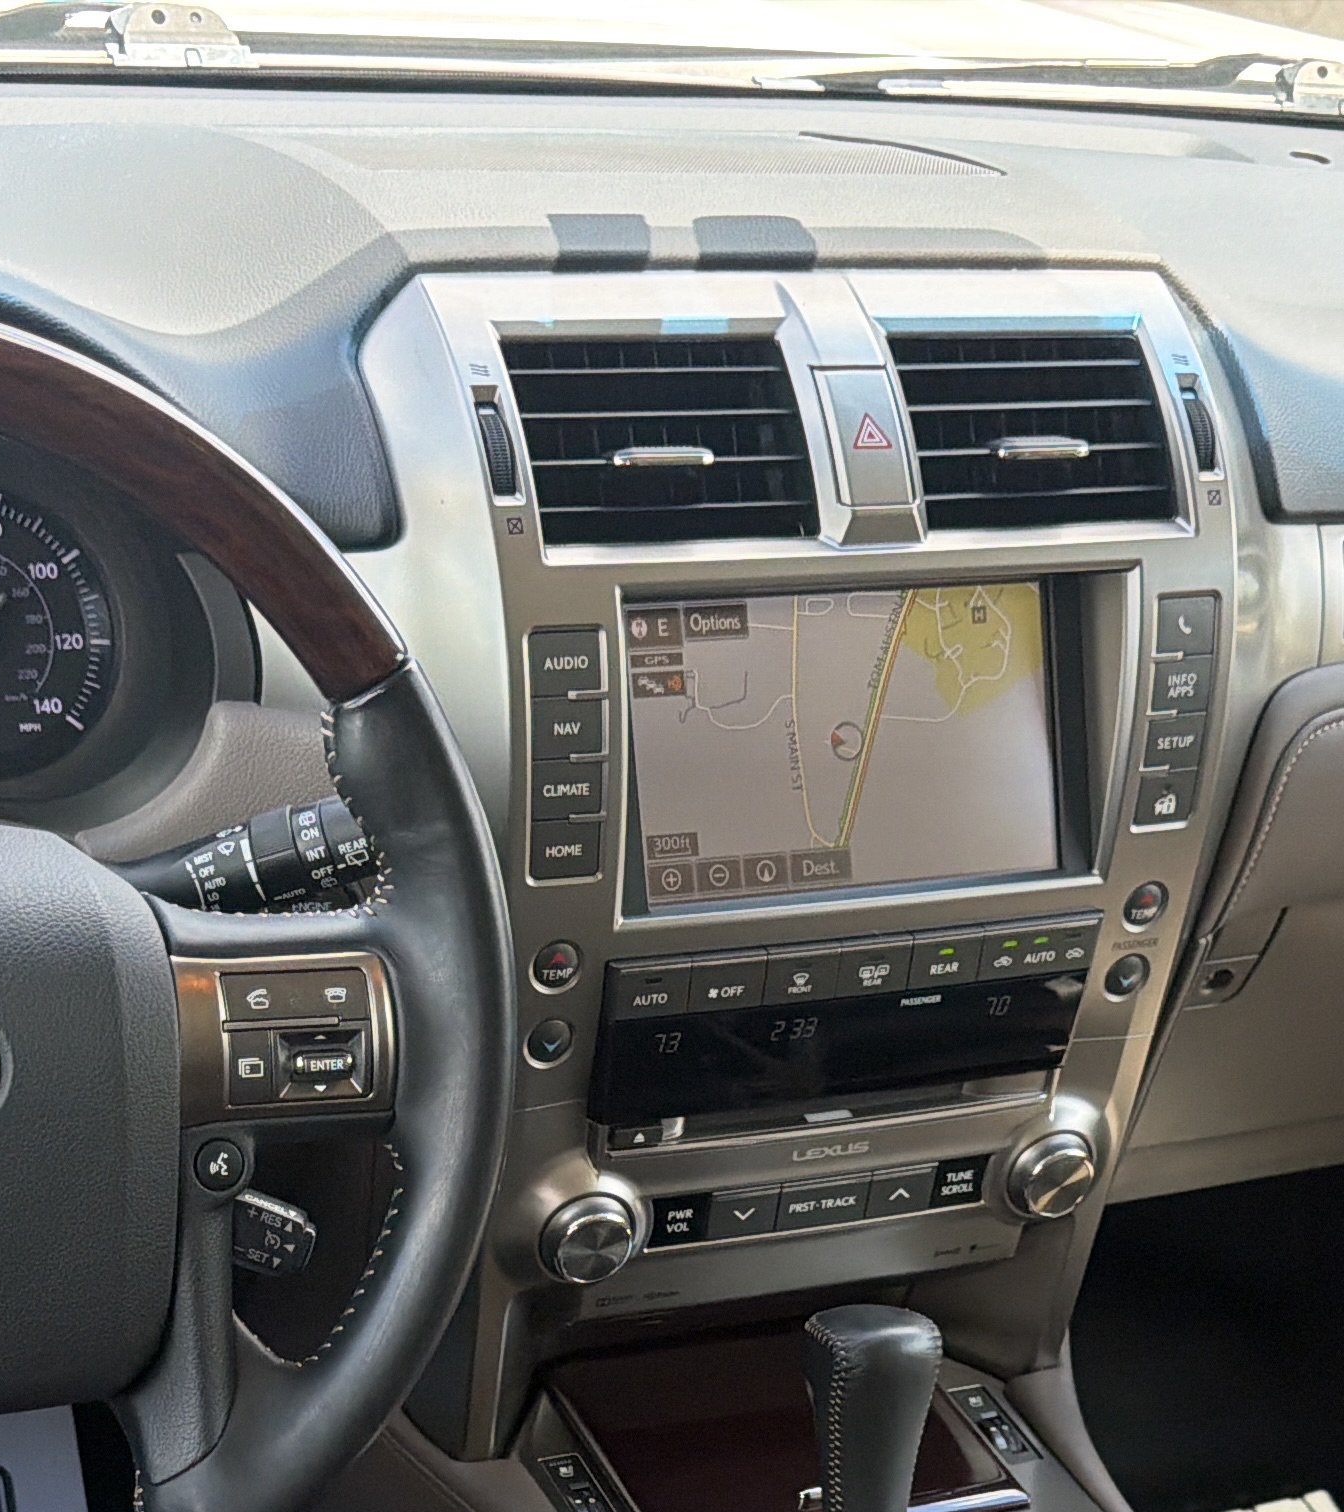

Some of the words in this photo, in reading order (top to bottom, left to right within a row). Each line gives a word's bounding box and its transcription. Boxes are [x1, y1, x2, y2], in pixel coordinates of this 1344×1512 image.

[28, 562, 58, 580] 100
[657, 618, 670, 637] E
[689, 612, 742, 636] Options
[54, 633, 84, 652] 120
[544, 655, 589, 671] AUDIO
[644, 655, 670, 665] GPS
[1168, 672, 1198, 687] INFO
[1167, 686, 1195, 700] APPS
[33, 697, 63, 715] 140
[19, 723, 42, 733] MPH
[553, 722, 581, 735] NAV
[1157, 735, 1195, 750] SETUP
[786, 732, 801, 771] MAIN
[543, 783, 590, 797] CLIMATE
[791, 774, 803, 791] ST
[300, 826, 320, 841] ON
[337, 837, 369, 855] REAR
[652, 835, 691, 851] 300ft
[193, 852, 214, 865] MIST
[305, 845, 326, 862] INT
[545, 844, 583, 858] HOME
[198, 865, 216, 878] OFF
[311, 865, 334, 880] OFF
[802, 859, 840, 876] Dest.
[204, 877, 227, 891] AUTO
[207, 892, 220, 902] LO
[282, 888, 306, 899] AUTO
[542, 967, 573, 981] TEMP
[633, 993, 668, 1007] AUTO
[721, 985, 745, 998] OFF
[788, 985, 813, 995] FRONT
[863, 978, 883, 987] REAR
[929, 961, 959, 976] REAR
[1024, 950, 1056, 964] AUTO
[655, 1032, 682, 1054] 73
[309, 1059, 344, 1072] ENTER
[791, 1141, 870, 1161] LEXUS
[946, 1169, 974, 1183] TUNE
[940, 1182, 973, 1196] SCROLL
[245, 1194, 286, 1215] CANCEL
[260, 1211, 283, 1228] RES
[667, 1208, 694, 1221] PWR
[666, 1222, 690, 1234] VOL
[246, 1248, 269, 1264] SET
